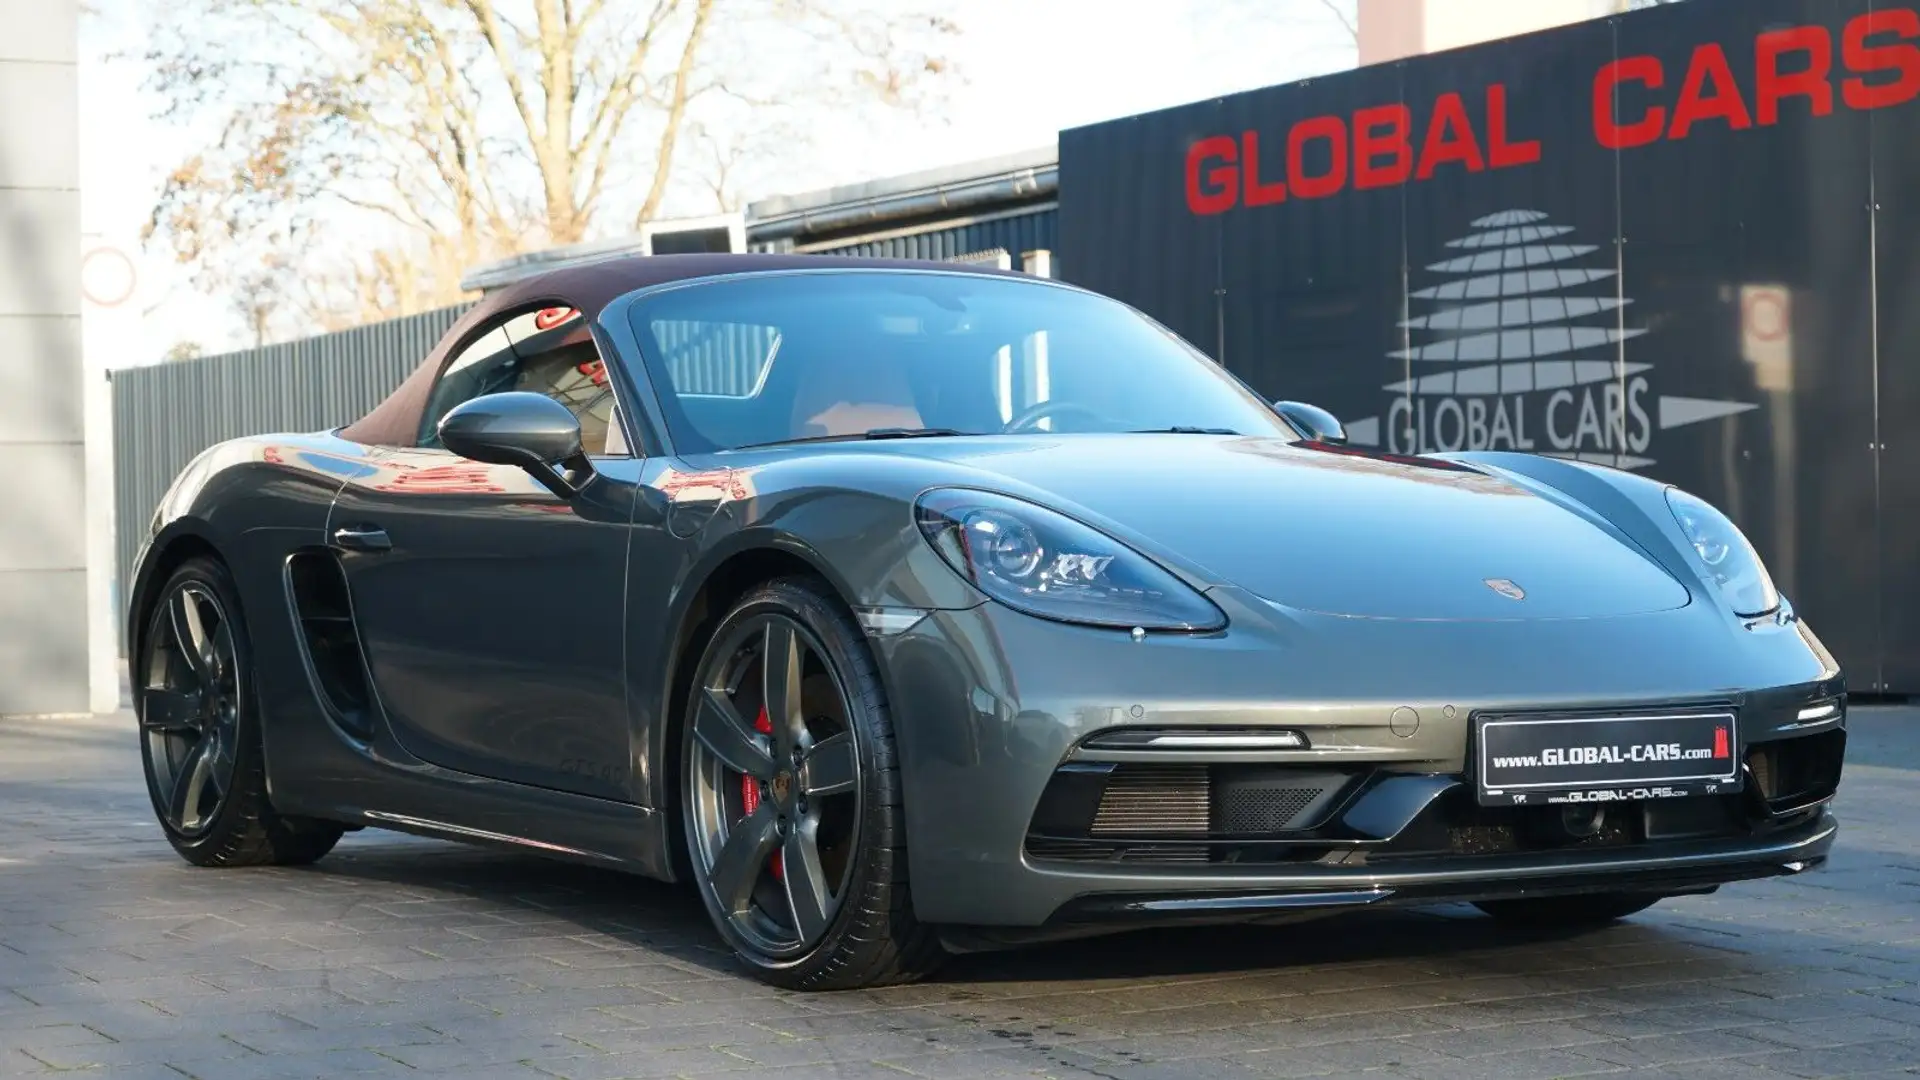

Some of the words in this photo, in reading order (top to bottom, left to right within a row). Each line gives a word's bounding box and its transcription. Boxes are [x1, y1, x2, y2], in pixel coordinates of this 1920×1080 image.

[1185, 84, 1541, 215] GLOBAL
[1592, 8, 1920, 149] CARS
[1388, 396, 1534, 456] GLOBAL
[1547, 376, 1651, 453] CARS
[1493, 743, 1712, 769] www.GLOBAL-CARS.com
